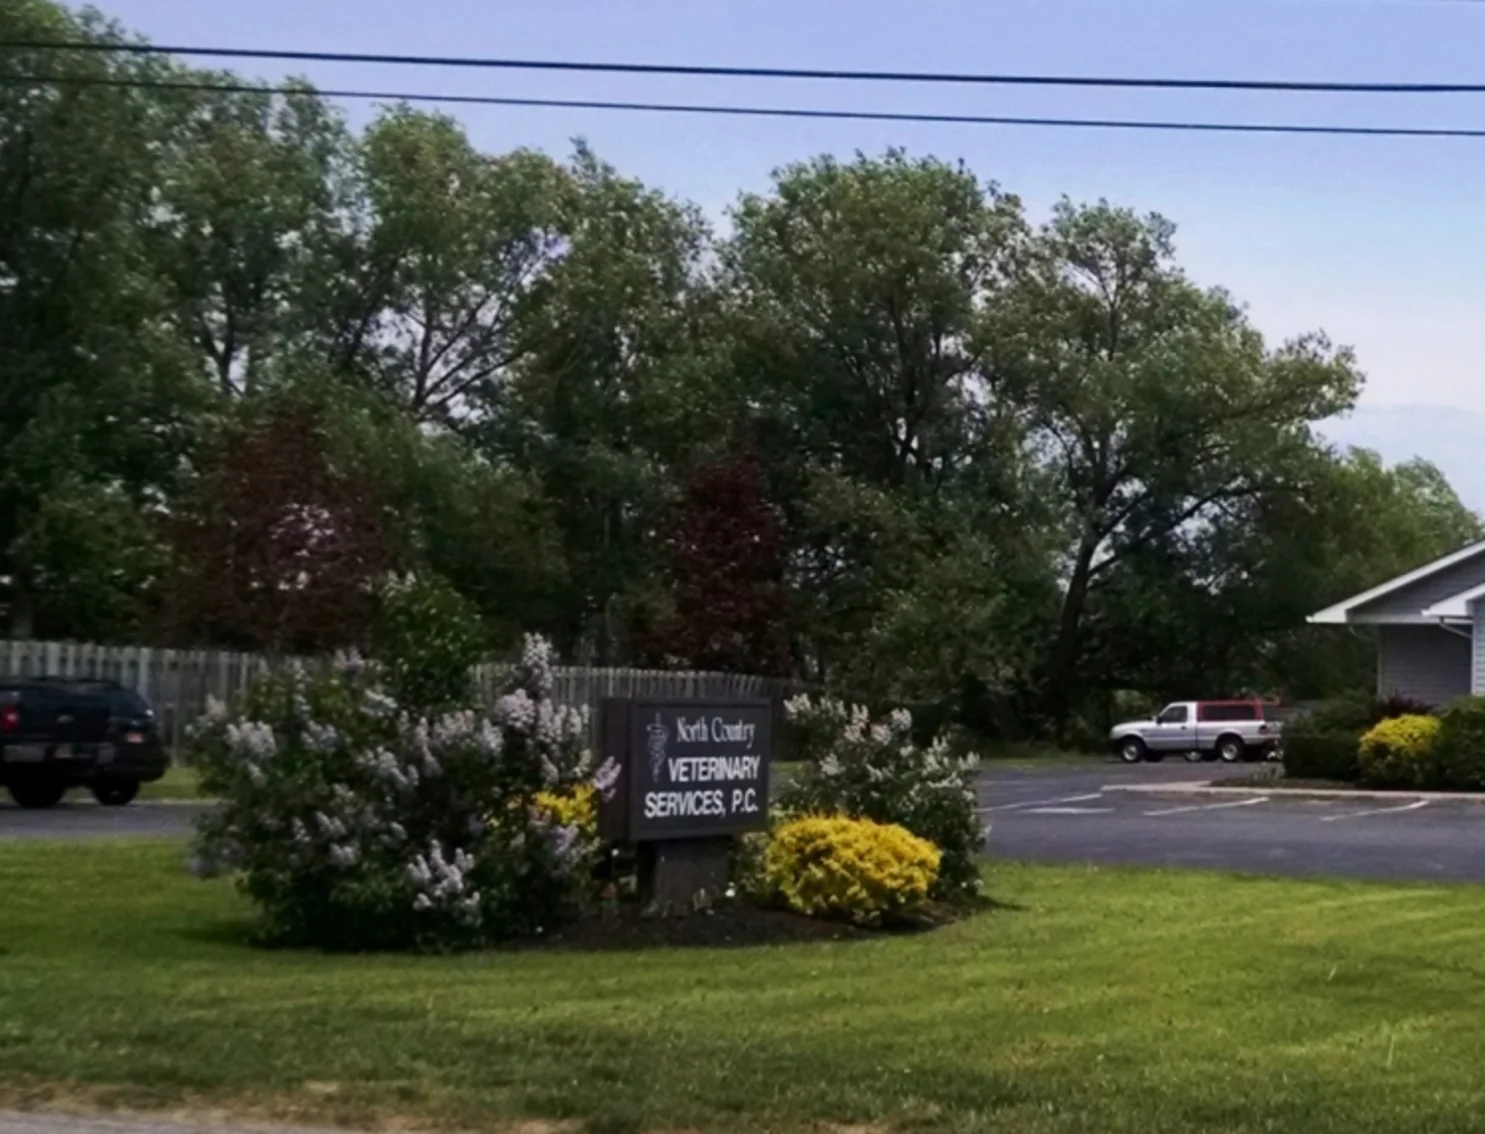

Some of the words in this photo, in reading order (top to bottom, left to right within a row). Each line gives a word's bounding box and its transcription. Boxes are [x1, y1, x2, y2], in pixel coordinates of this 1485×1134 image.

[676, 716, 709, 742] North
[711, 716, 756, 749] Country
[668, 756, 761, 782] VETERINARY
[644, 789, 726, 818] SERVICES,
[731, 787, 759, 813] P.C.
